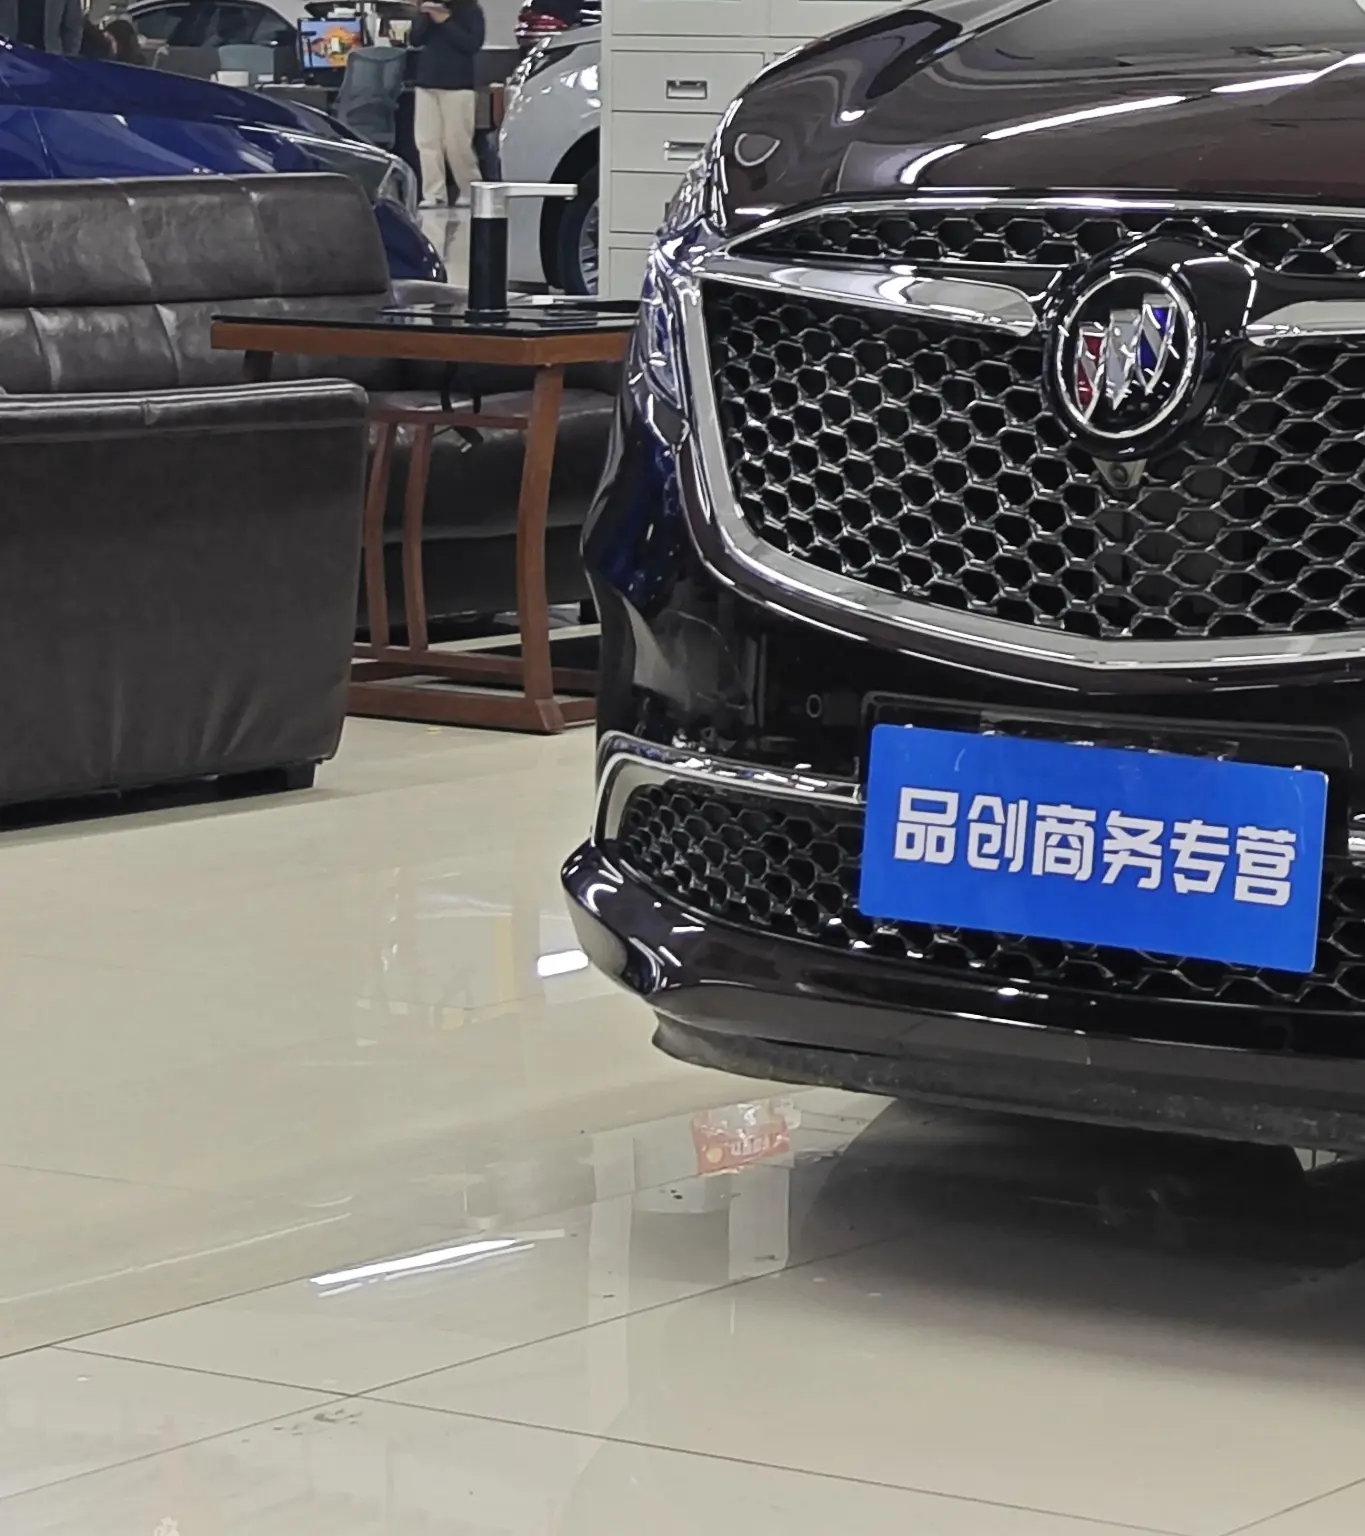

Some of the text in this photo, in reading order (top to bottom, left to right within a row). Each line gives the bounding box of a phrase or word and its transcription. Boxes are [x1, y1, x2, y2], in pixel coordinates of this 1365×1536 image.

[893, 786, 1298, 907] 品创商务专营
